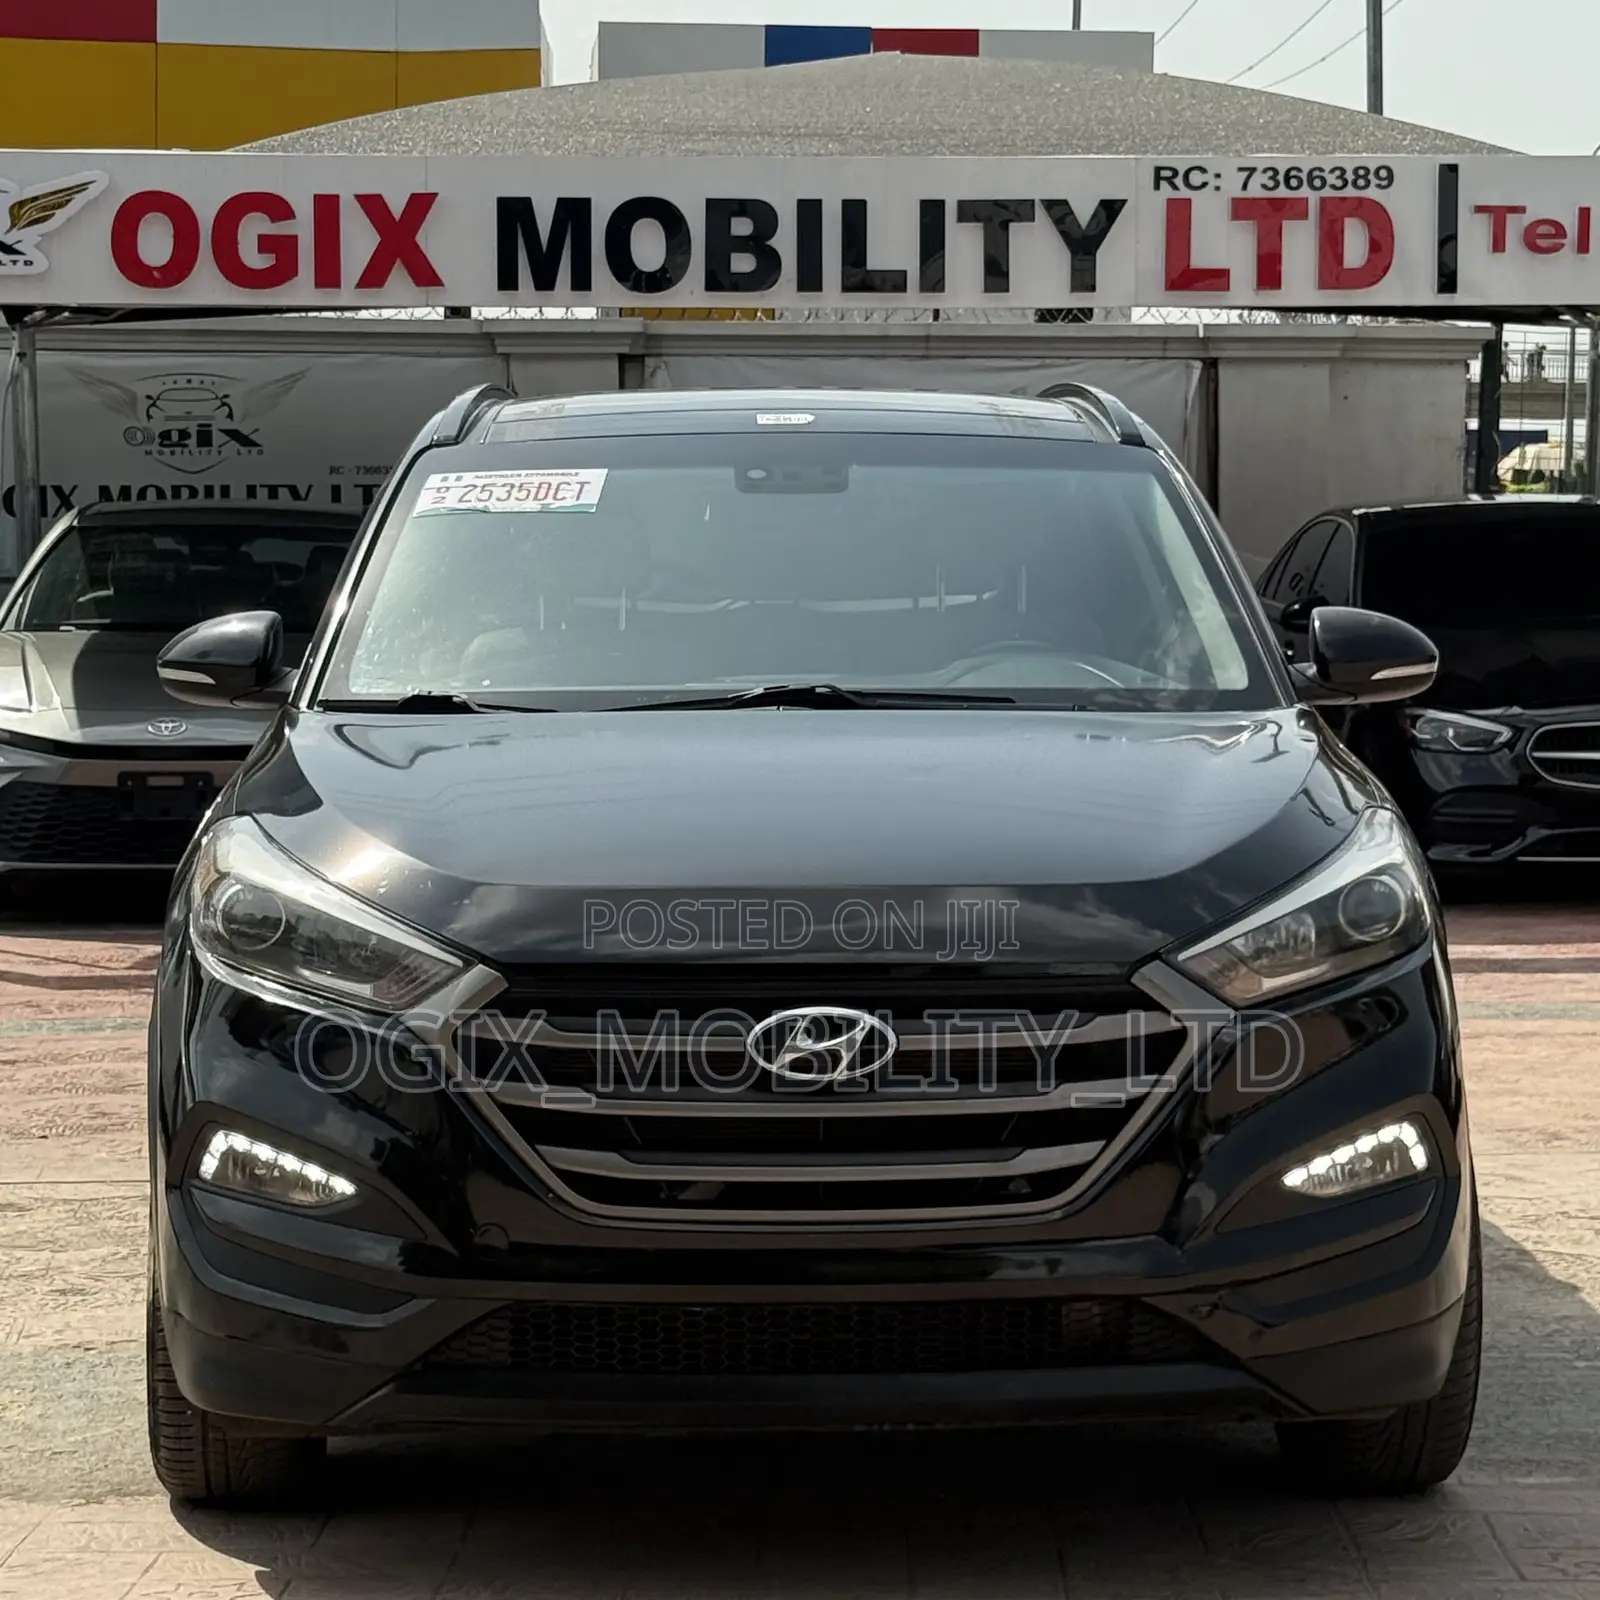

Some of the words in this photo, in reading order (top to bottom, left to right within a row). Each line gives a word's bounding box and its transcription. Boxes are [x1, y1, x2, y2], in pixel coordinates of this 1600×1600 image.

[1152, 166, 1222, 191] RC:
[1236, 165, 1395, 191] 7366389
[110, 189, 445, 290] OGIX
[497, 196, 1128, 294] MOBILITY
[1163, 196, 1395, 292] LTD
[1473, 204, 1591, 255] Tel
[236, 448, 265, 456] LTD
